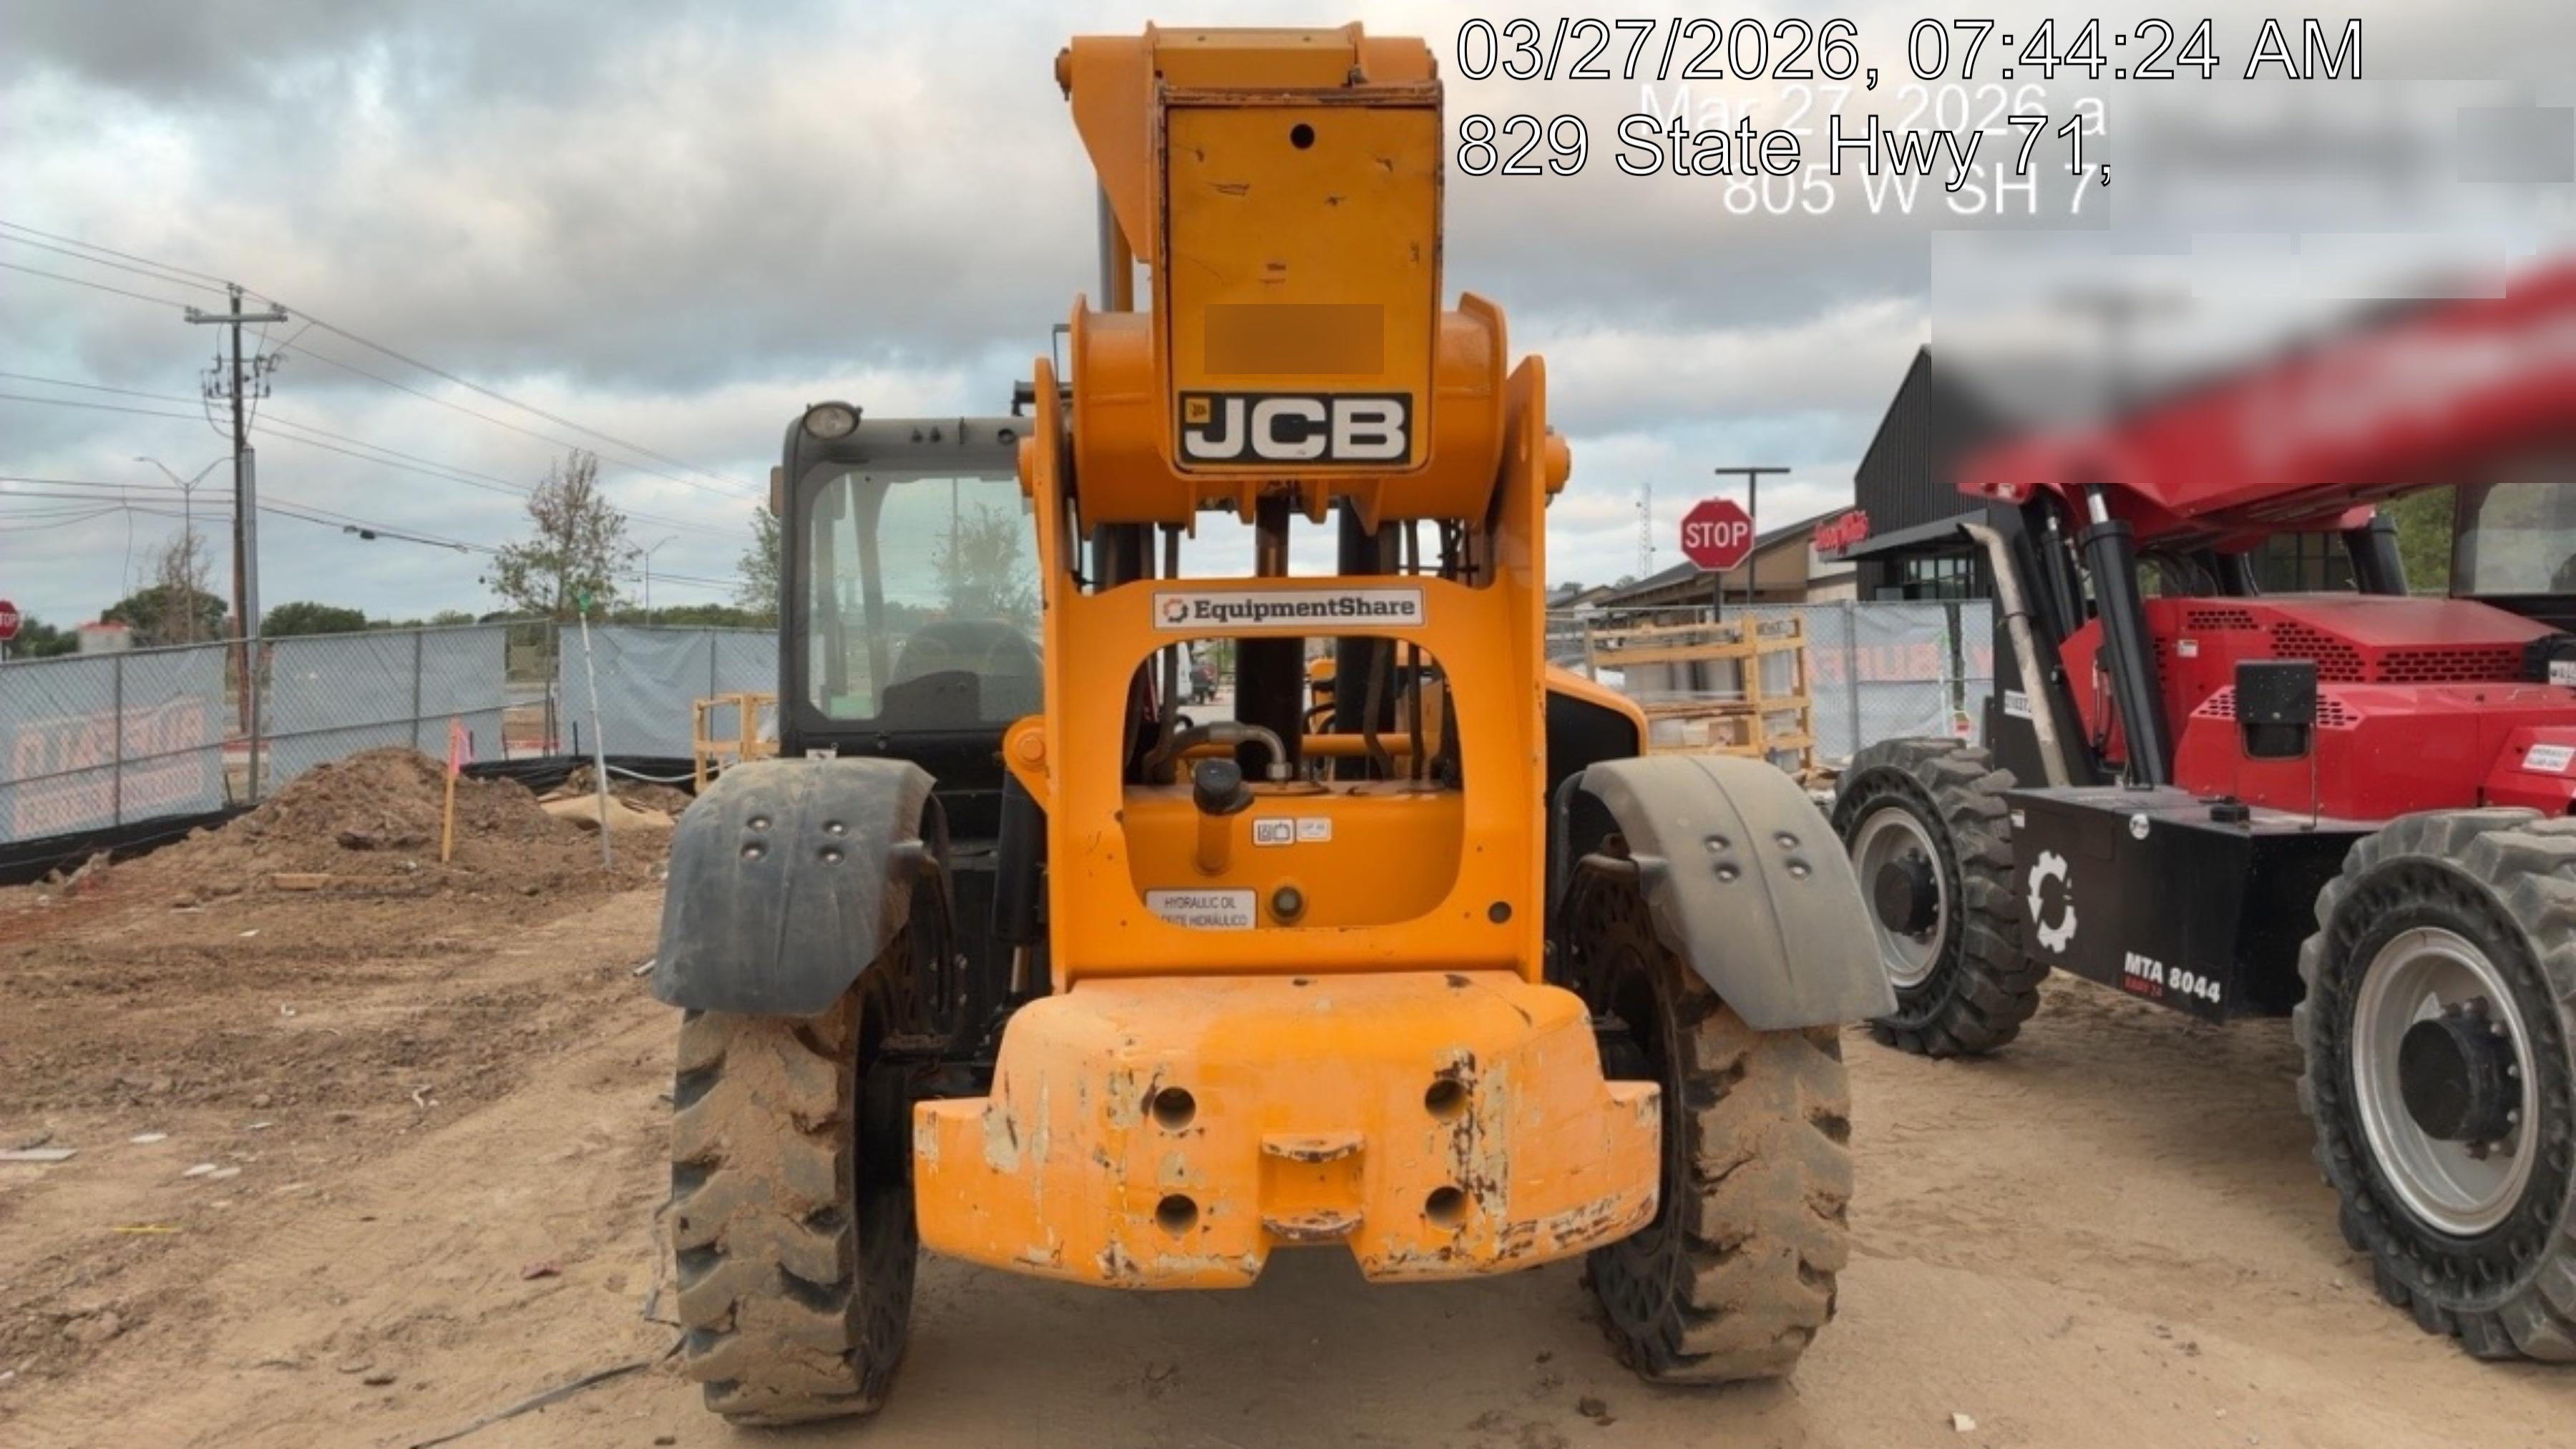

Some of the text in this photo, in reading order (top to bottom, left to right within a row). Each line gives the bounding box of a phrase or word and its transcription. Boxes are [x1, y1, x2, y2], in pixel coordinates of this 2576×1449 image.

[1184, 398, 1405, 459] JCB
[1685, 521, 1748, 548] STOP
[1194, 597, 1415, 623] EquipmentShare
[1165, 897, 1236, 909] HYDRAULIC OIL
[2124, 950, 2163, 985] MTA
[2169, 967, 2221, 1004] 8044
